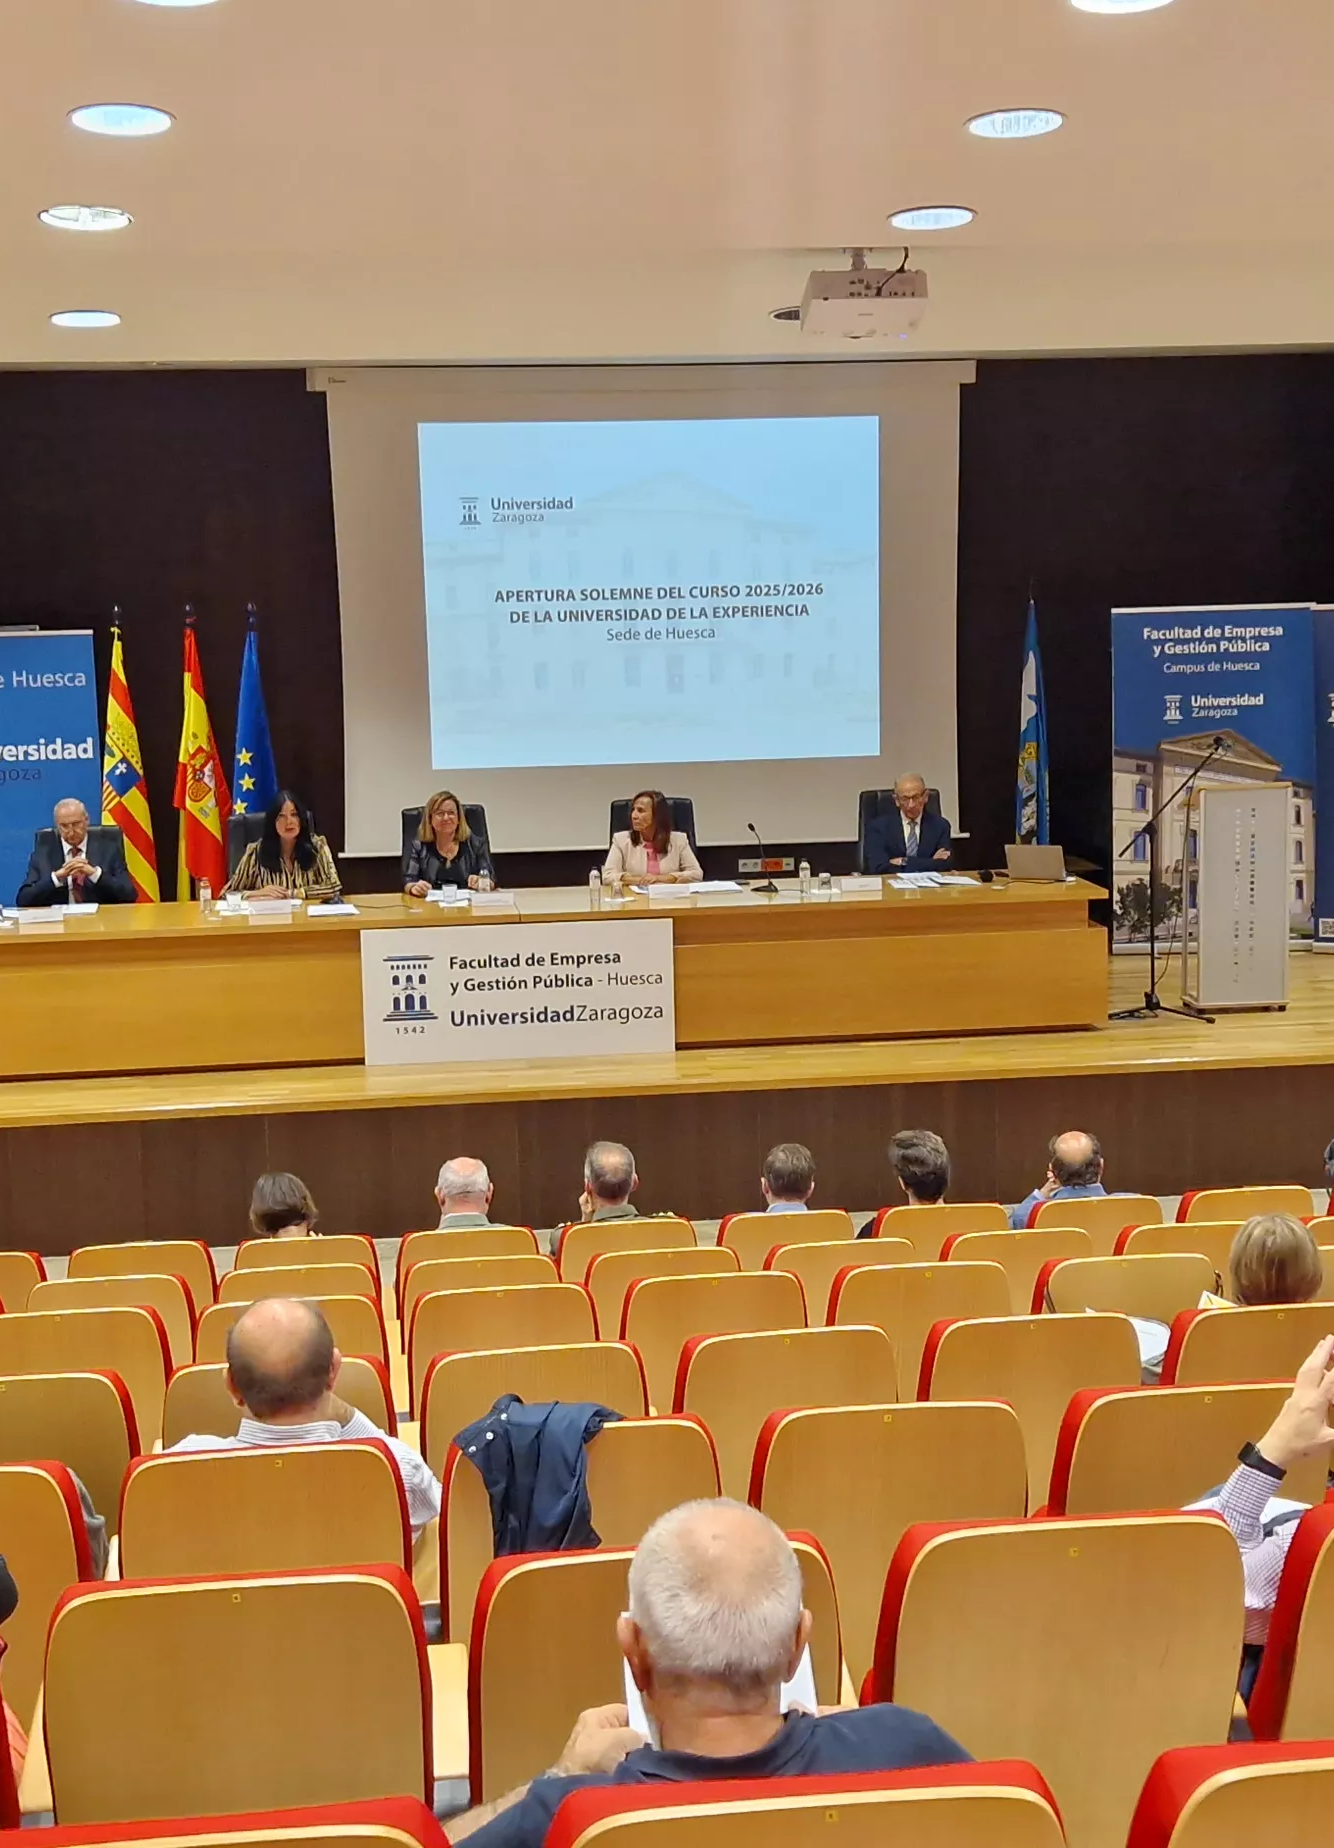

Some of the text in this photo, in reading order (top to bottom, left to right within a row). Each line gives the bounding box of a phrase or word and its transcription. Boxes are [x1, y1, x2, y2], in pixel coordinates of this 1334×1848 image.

[491, 496, 573, 510] Universidad
[492, 512, 544, 524] Zaragoza
[495, 583, 823, 603] APERTURA SOLEMNE DEL CURSO 2025/2026
[510, 604, 809, 623] DE LA UNIVERSIDAD DE LA EXPERIENCIA
[607, 627, 715, 641] Sede de Huesca
[1143, 625, 1283, 640] Facultad de Empresa
[1153, 639, 1270, 657] y Gestión Pública
[1163, 661, 1260, 674] Campus de Huesca
[12, 670, 86, 687] Huesca
[1191, 693, 1264, 707] Universidad
[1192, 707, 1238, 718] Zaragoza
[449, 952, 621, 970] Facultad de Empresa
[450, 982, 459, 996] y
[464, 976, 528, 991] Gestión
[533, 974, 593, 989] Pública
[607, 972, 663, 986] Huesca
[395, 1026, 425, 1035] 1542
